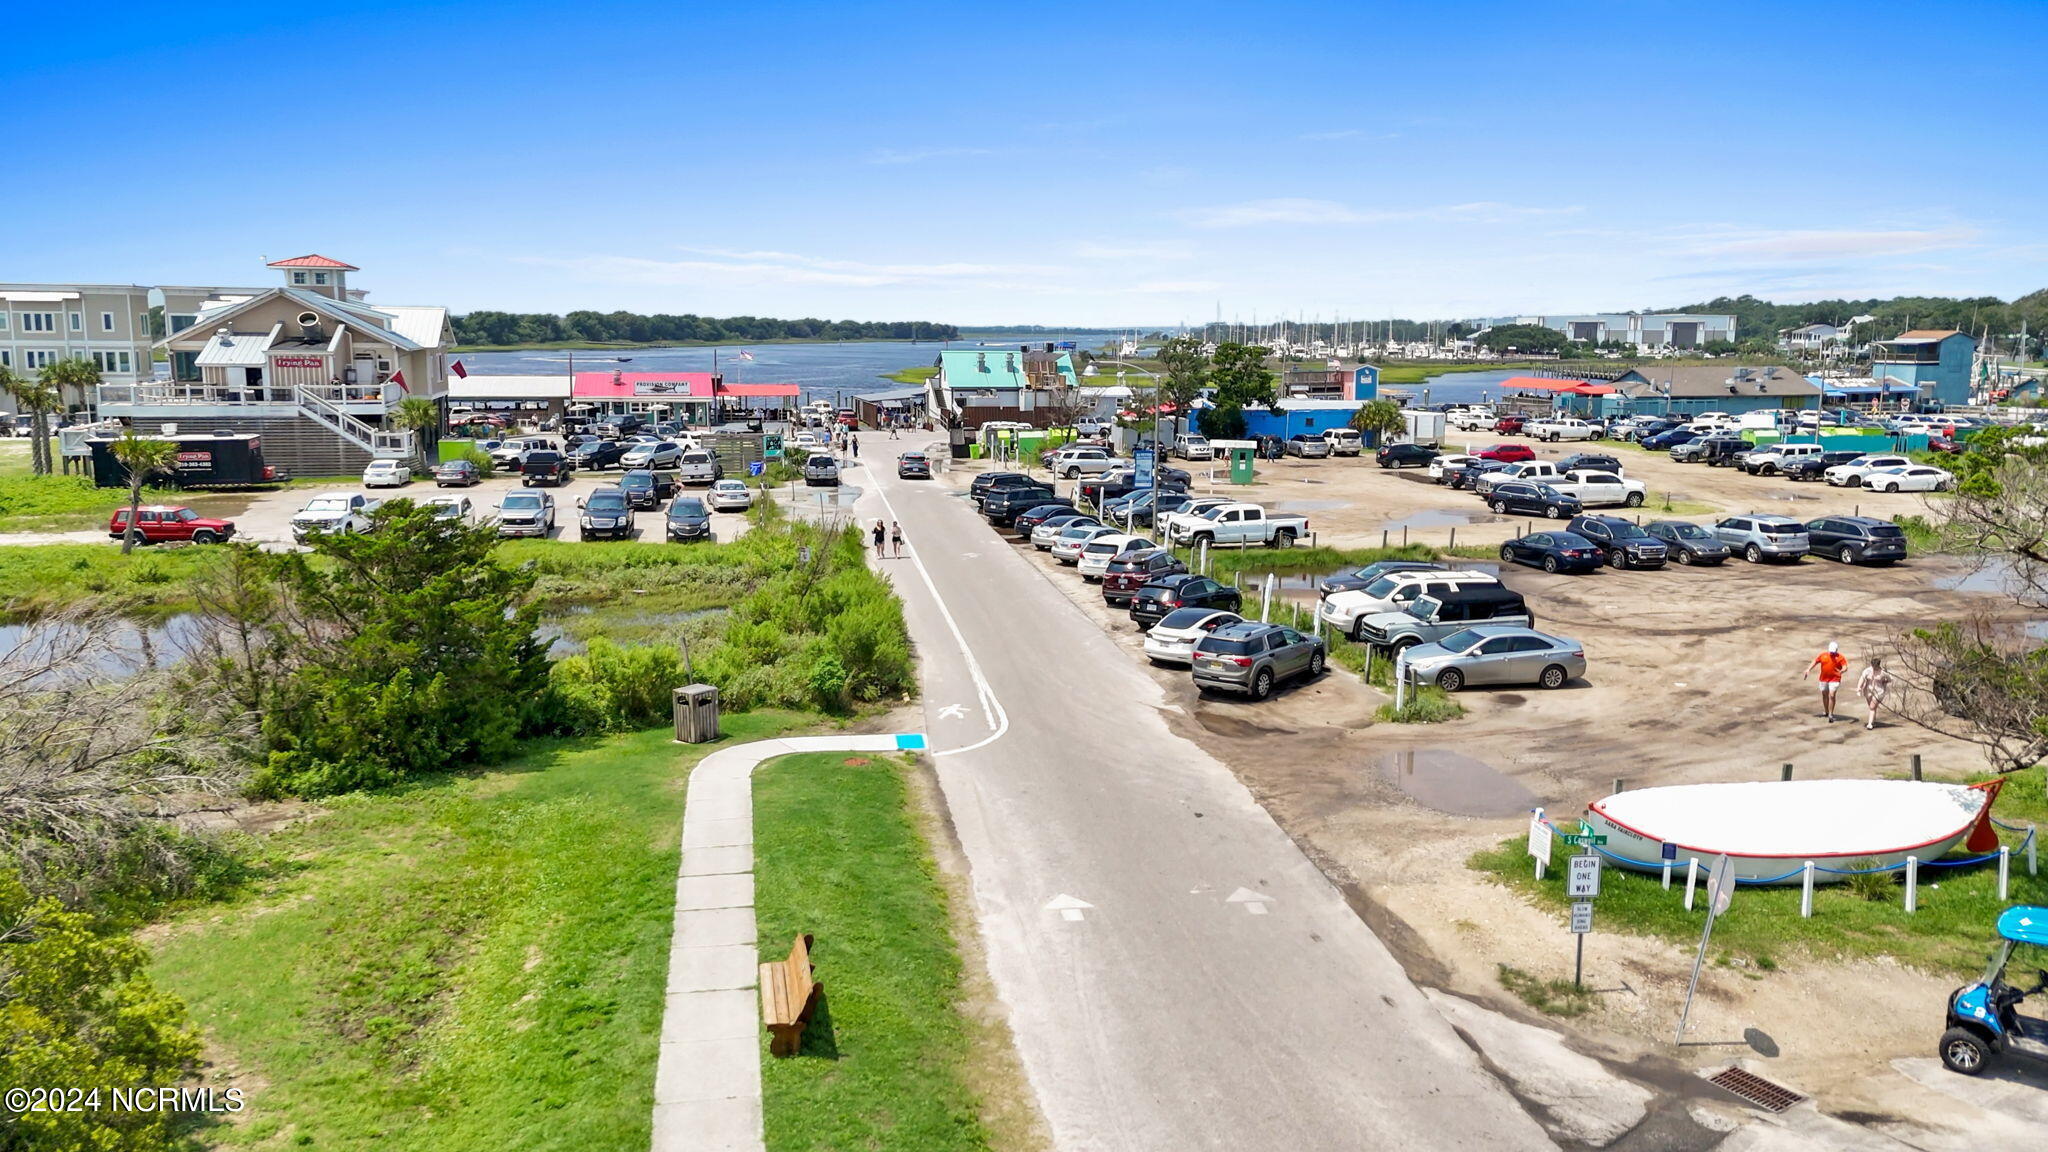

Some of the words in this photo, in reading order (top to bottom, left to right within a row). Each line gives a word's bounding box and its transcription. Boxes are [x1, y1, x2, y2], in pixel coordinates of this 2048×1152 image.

[1567, 835, 1572, 844] S
[1573, 860, 1596, 869] BEGIN
[1576, 872, 1592, 880] ONE
[1575, 884, 1591, 893] WAY
